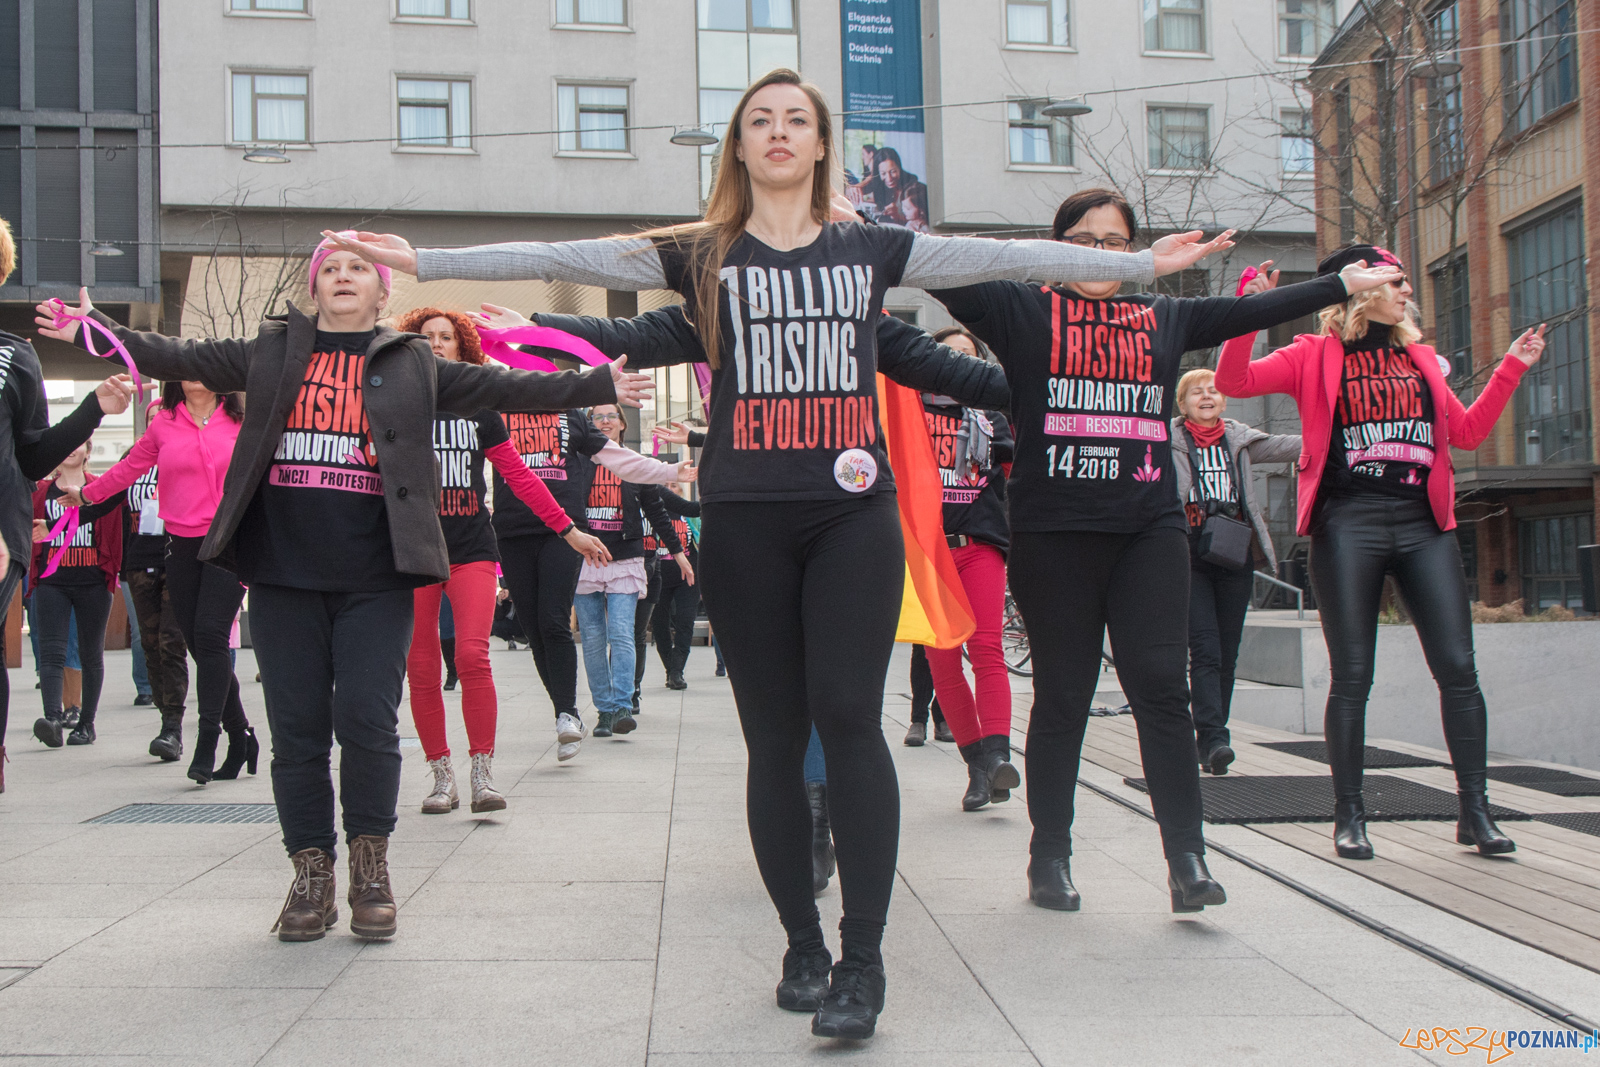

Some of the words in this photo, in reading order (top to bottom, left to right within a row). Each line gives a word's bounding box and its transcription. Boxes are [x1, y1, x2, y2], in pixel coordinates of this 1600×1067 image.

[847, 12, 892, 25] Elegancka
[848, 24, 894, 34] przestrzeń
[848, 43, 893, 55] Doskonała
[849, 53, 882, 64] kuchnia
[746, 265, 873, 322] BILLION
[750, 321, 859, 394] RISING
[1065, 324, 1153, 383] RISING
[1047, 377, 1142, 413] SOLIDARITY
[1346, 378, 1423, 423] RISING
[733, 396, 876, 450] REVOLUTION
[1047, 415, 1077, 432] RISE!
[1085, 417, 1132, 435] RESIST!
[1138, 420, 1162, 439] UNITE!
[1046, 444, 1075, 478] 14
[1079, 445, 1120, 458] FEBRUARY
[1077, 458, 1120, 480] 2018
